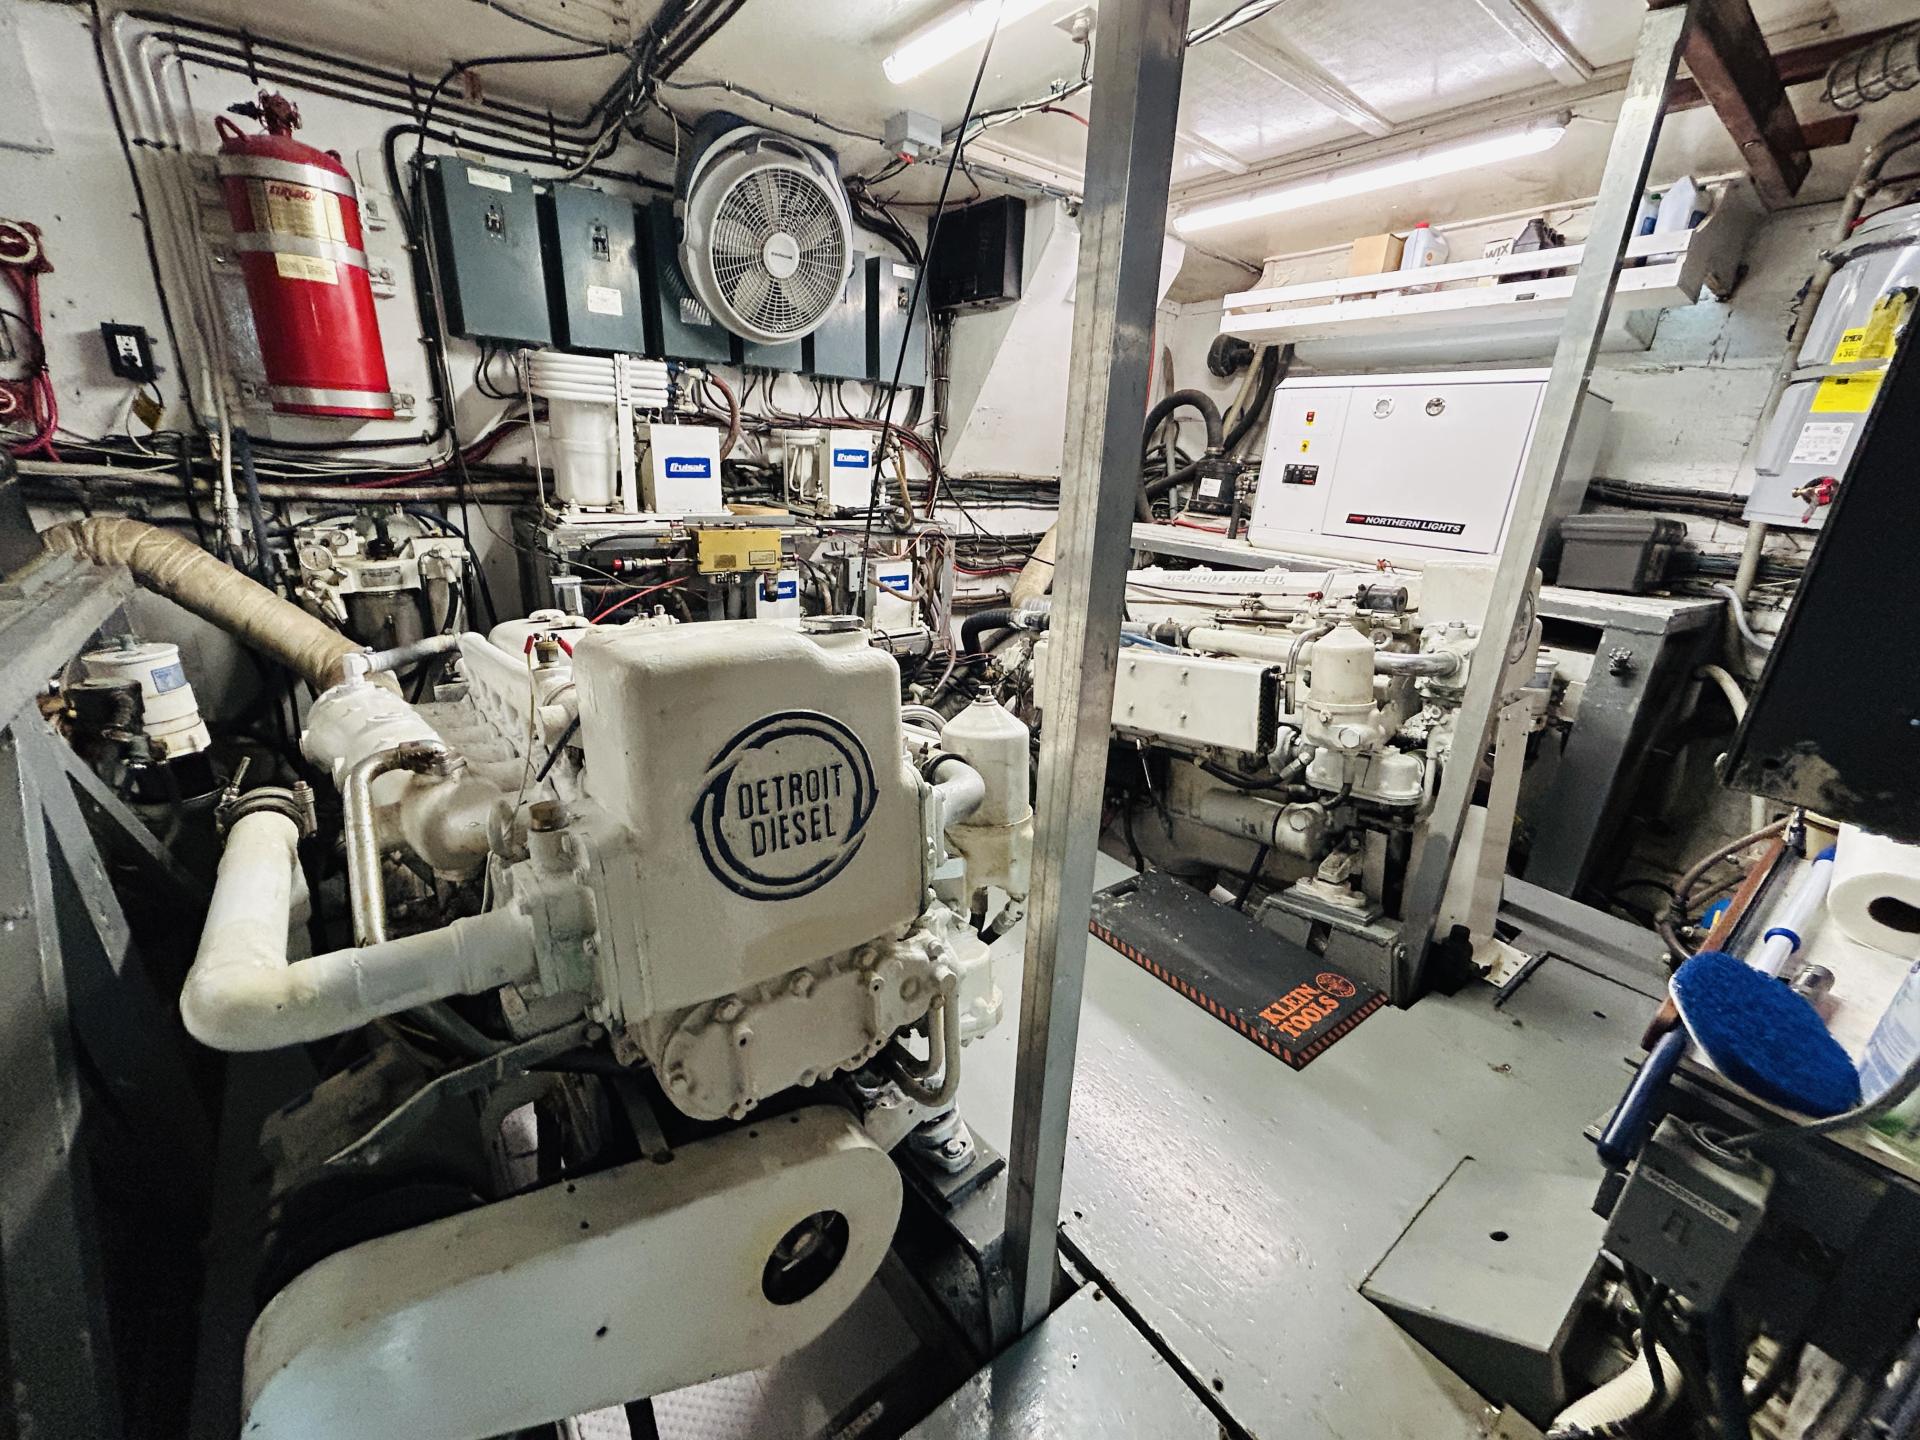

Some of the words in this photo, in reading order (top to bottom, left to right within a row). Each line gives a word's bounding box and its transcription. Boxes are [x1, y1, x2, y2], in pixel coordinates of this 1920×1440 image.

[1485, 243, 1509, 258] WIX
[1365, 516, 1420, 529] NORTHERN
[1421, 521, 1462, 533] LIGHTS
[738, 763, 843, 820] DETROIT
[751, 803, 836, 858] DIESEL
[1259, 983, 1320, 1025] KLEIN
[1278, 995, 1339, 1038] TOOLS
